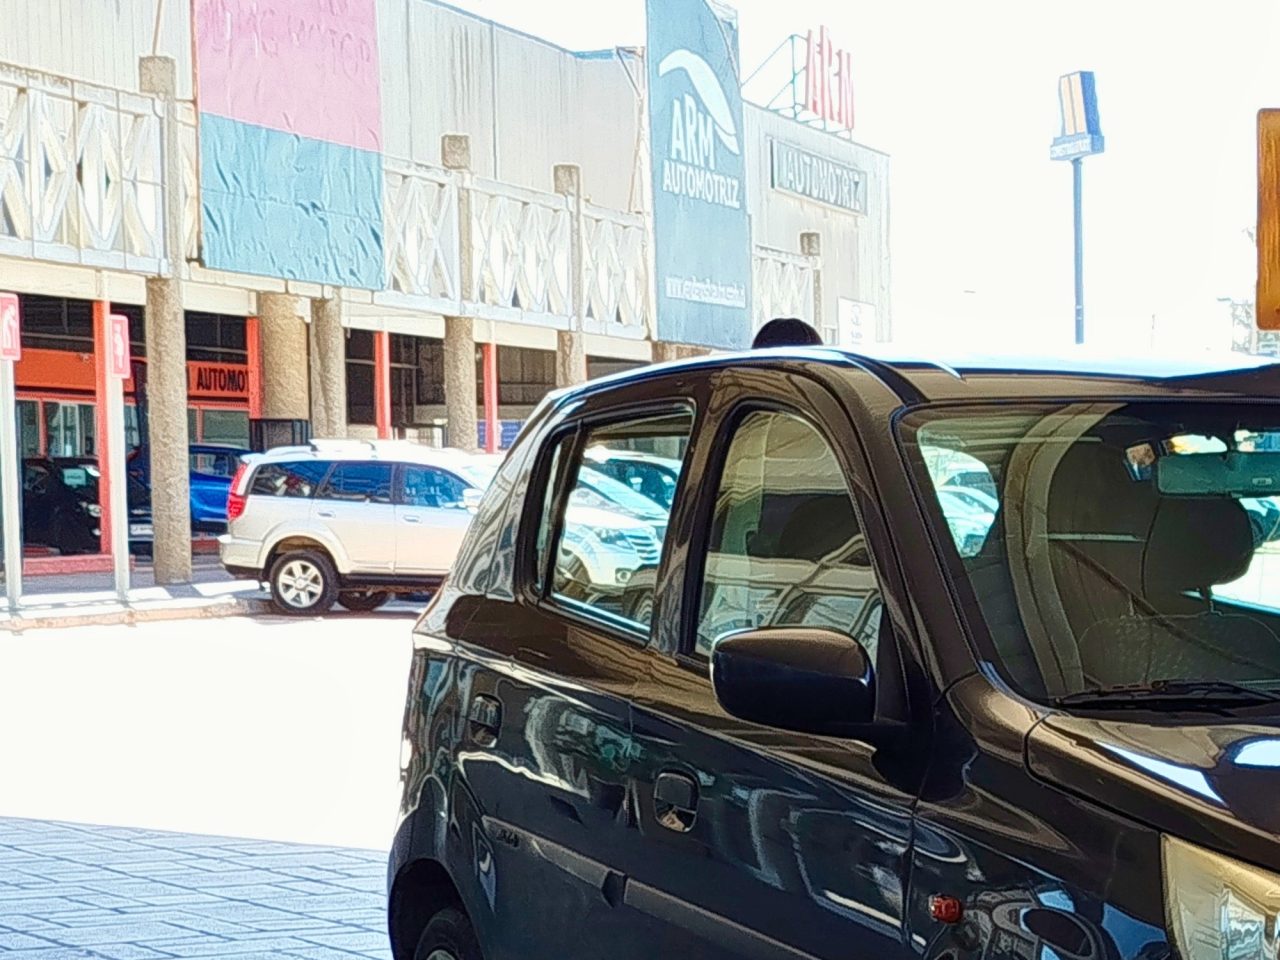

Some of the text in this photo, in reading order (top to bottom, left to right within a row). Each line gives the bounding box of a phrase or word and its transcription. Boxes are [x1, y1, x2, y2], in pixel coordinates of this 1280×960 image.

[671, 92, 715, 171] ARM
[662, 159, 740, 209] AUTOMOTRIZ
[787, 151, 861, 210] AUTOMOTRIZ
